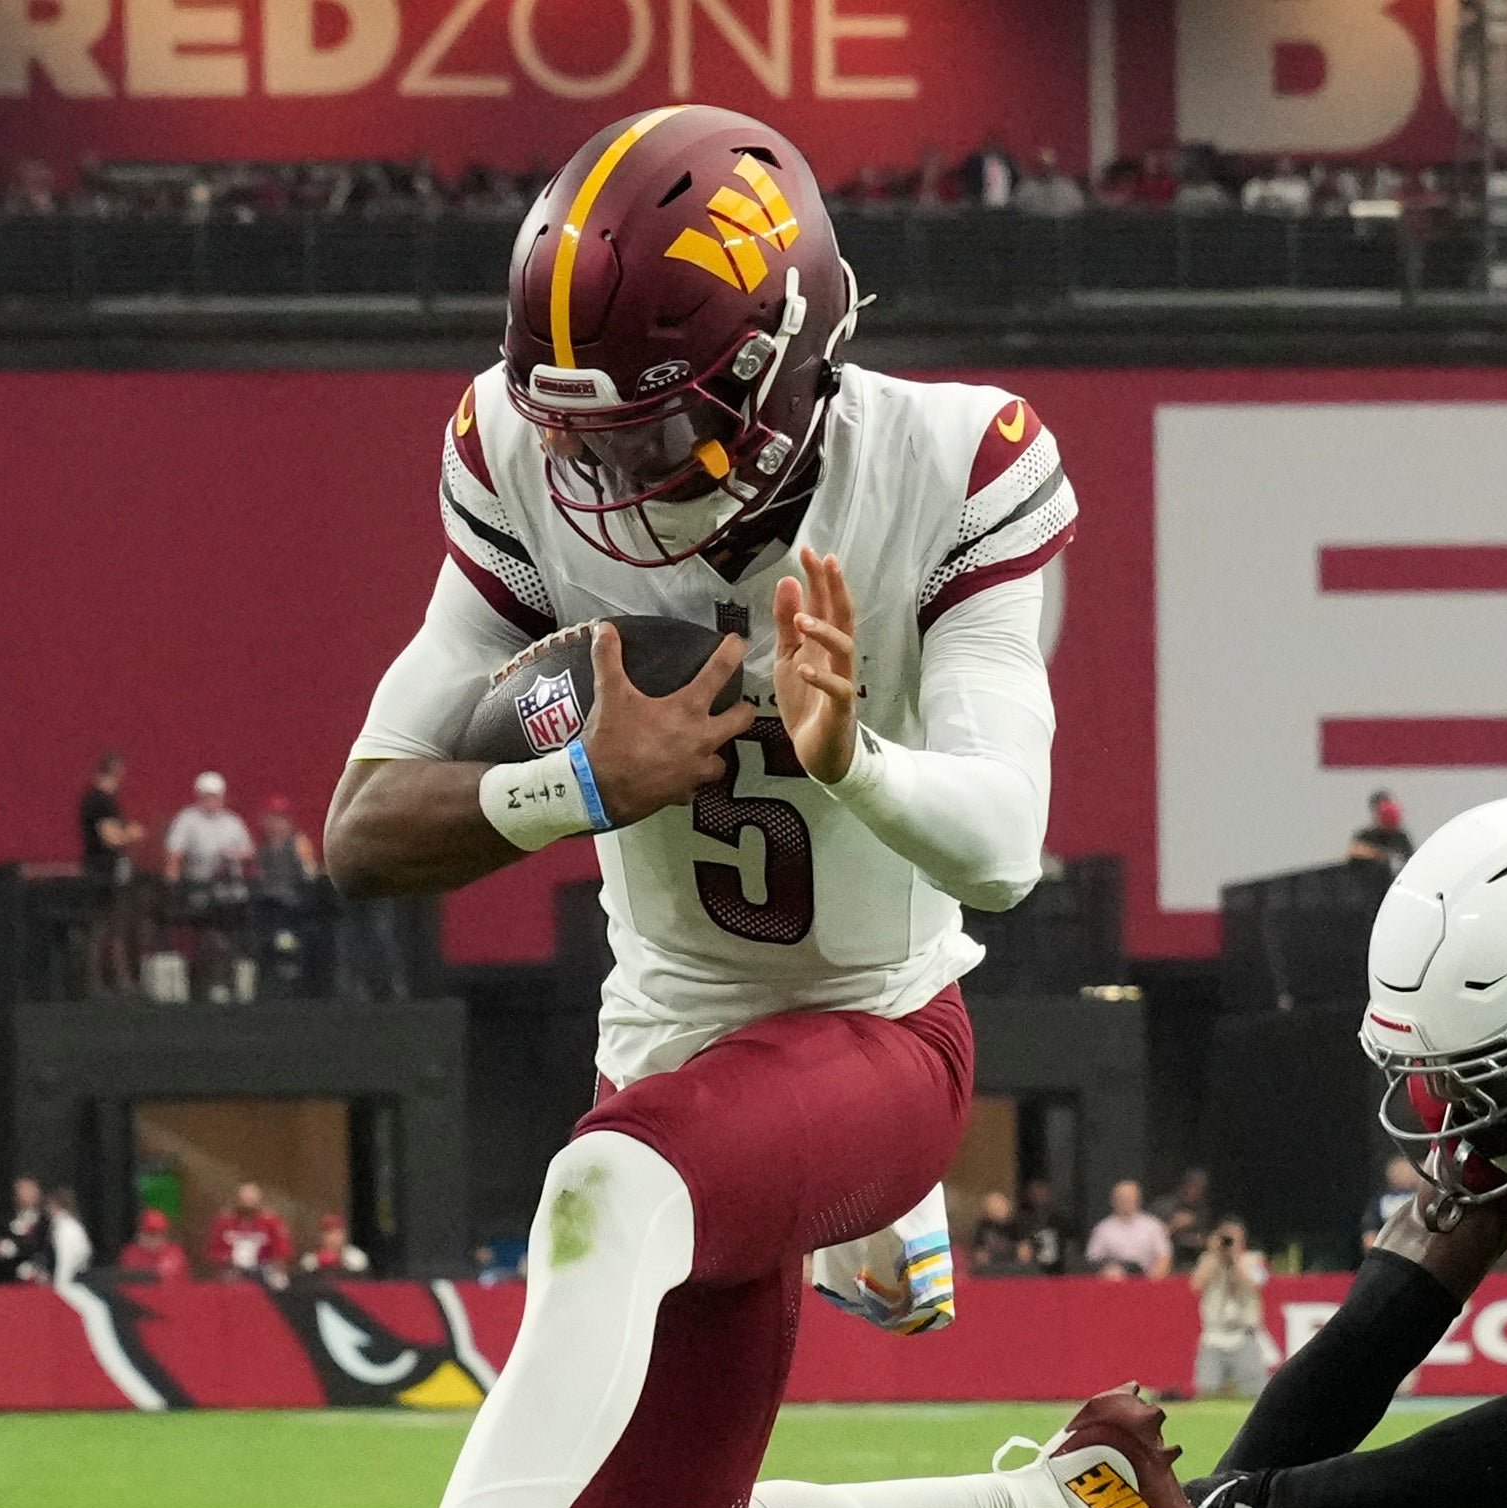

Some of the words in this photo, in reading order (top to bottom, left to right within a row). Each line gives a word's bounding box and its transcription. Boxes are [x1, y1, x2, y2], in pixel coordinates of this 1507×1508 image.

[640, 370, 689, 392] OAKLEY
[528, 702, 578, 747] NFL
[692, 716, 814, 945] 5
